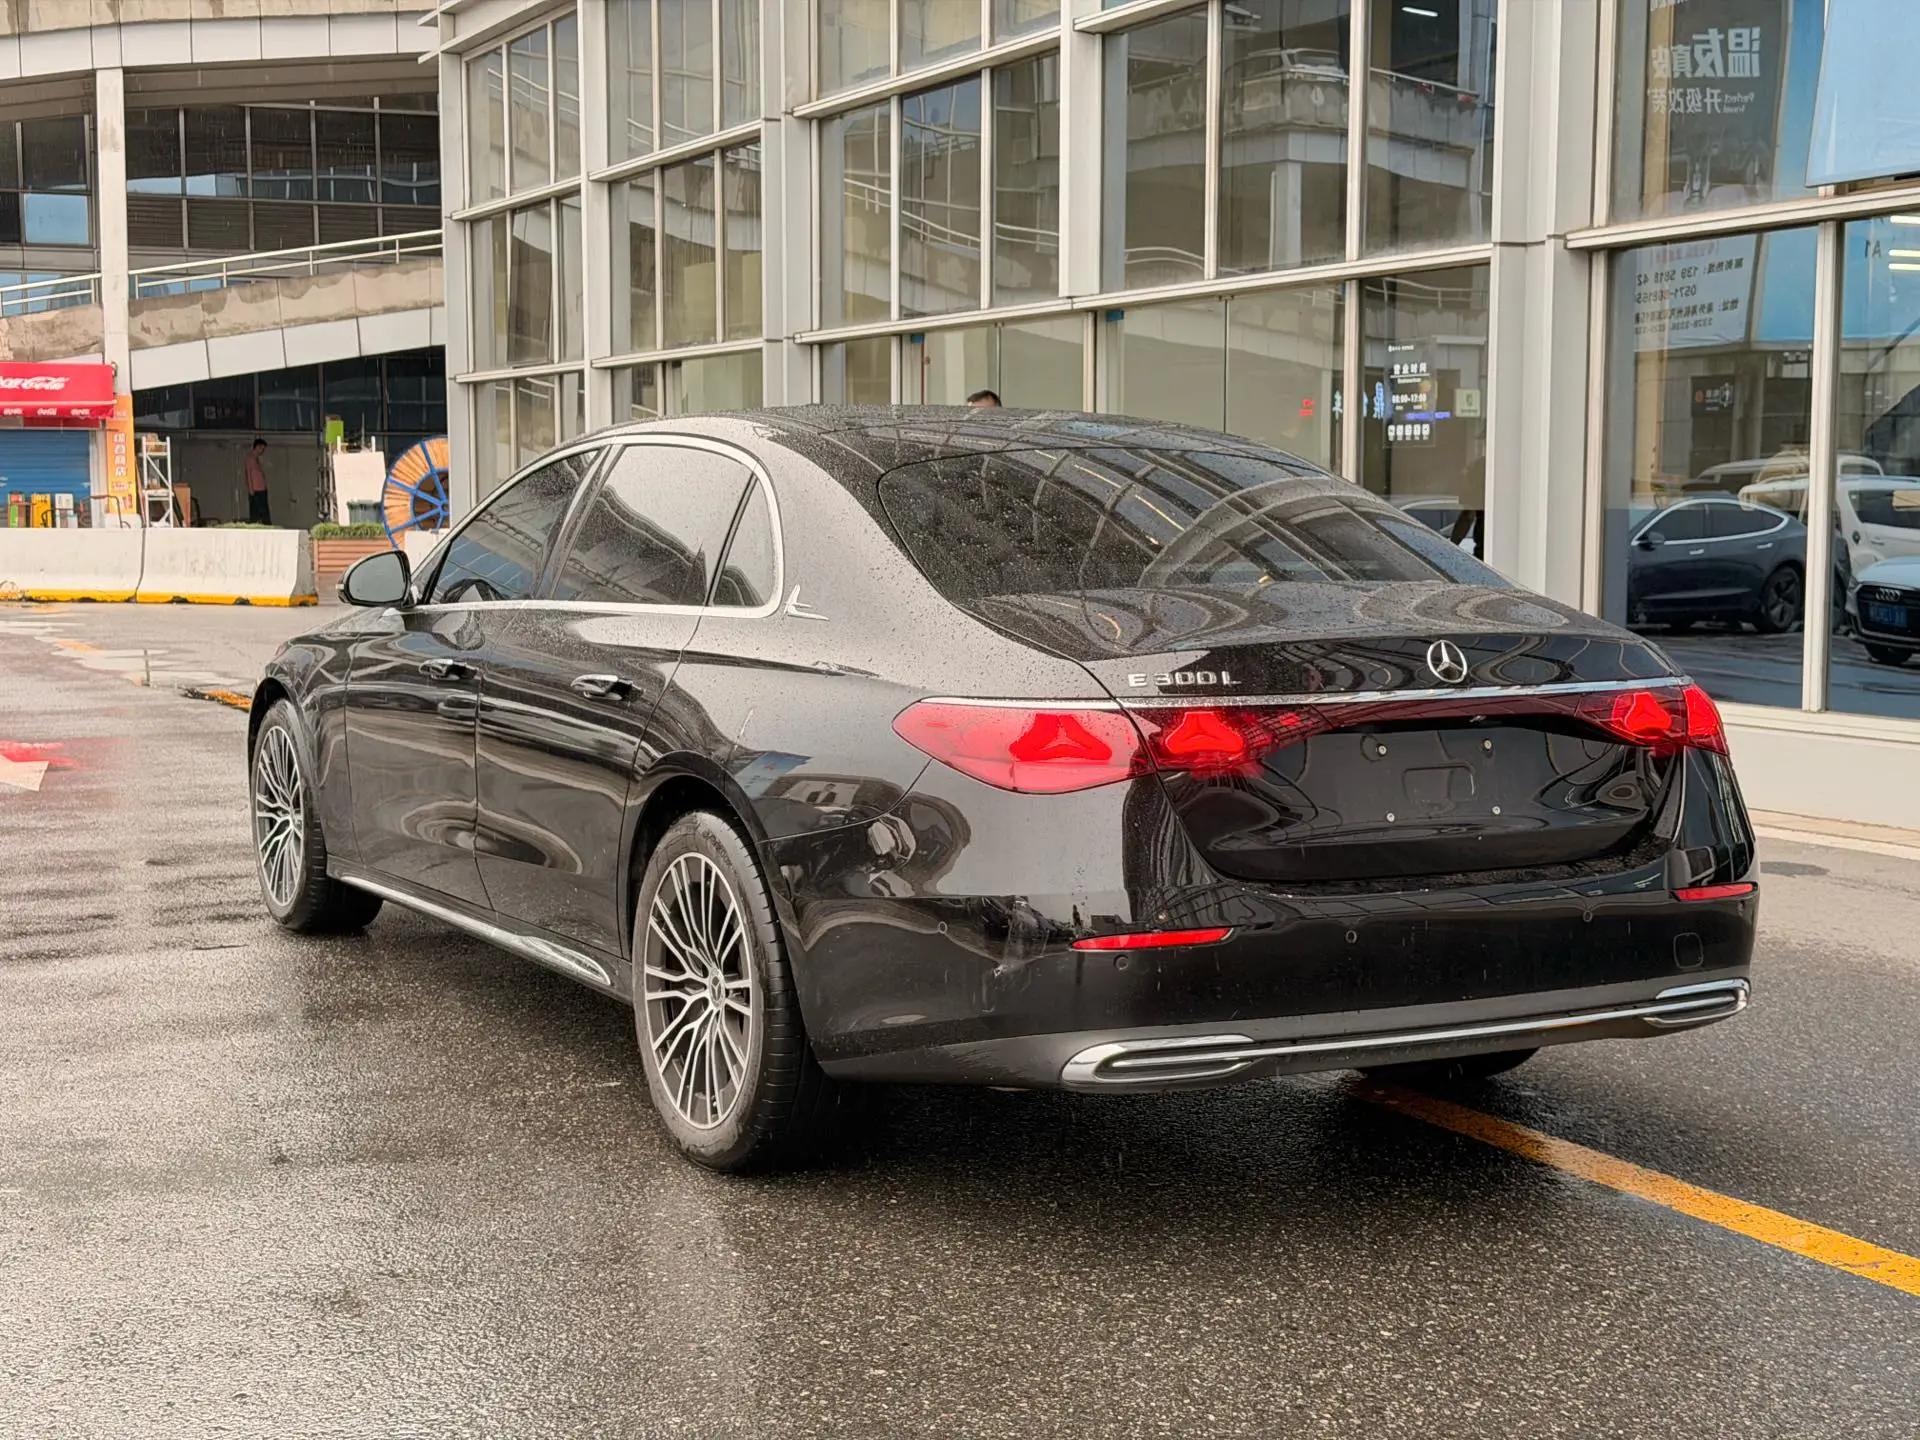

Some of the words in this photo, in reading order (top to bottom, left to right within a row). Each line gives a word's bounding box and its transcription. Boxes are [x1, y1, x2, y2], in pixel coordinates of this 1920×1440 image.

[1128, 673, 1147, 687] E
[1152, 671, 1218, 686] 300
[1221, 671, 1242, 687] L
